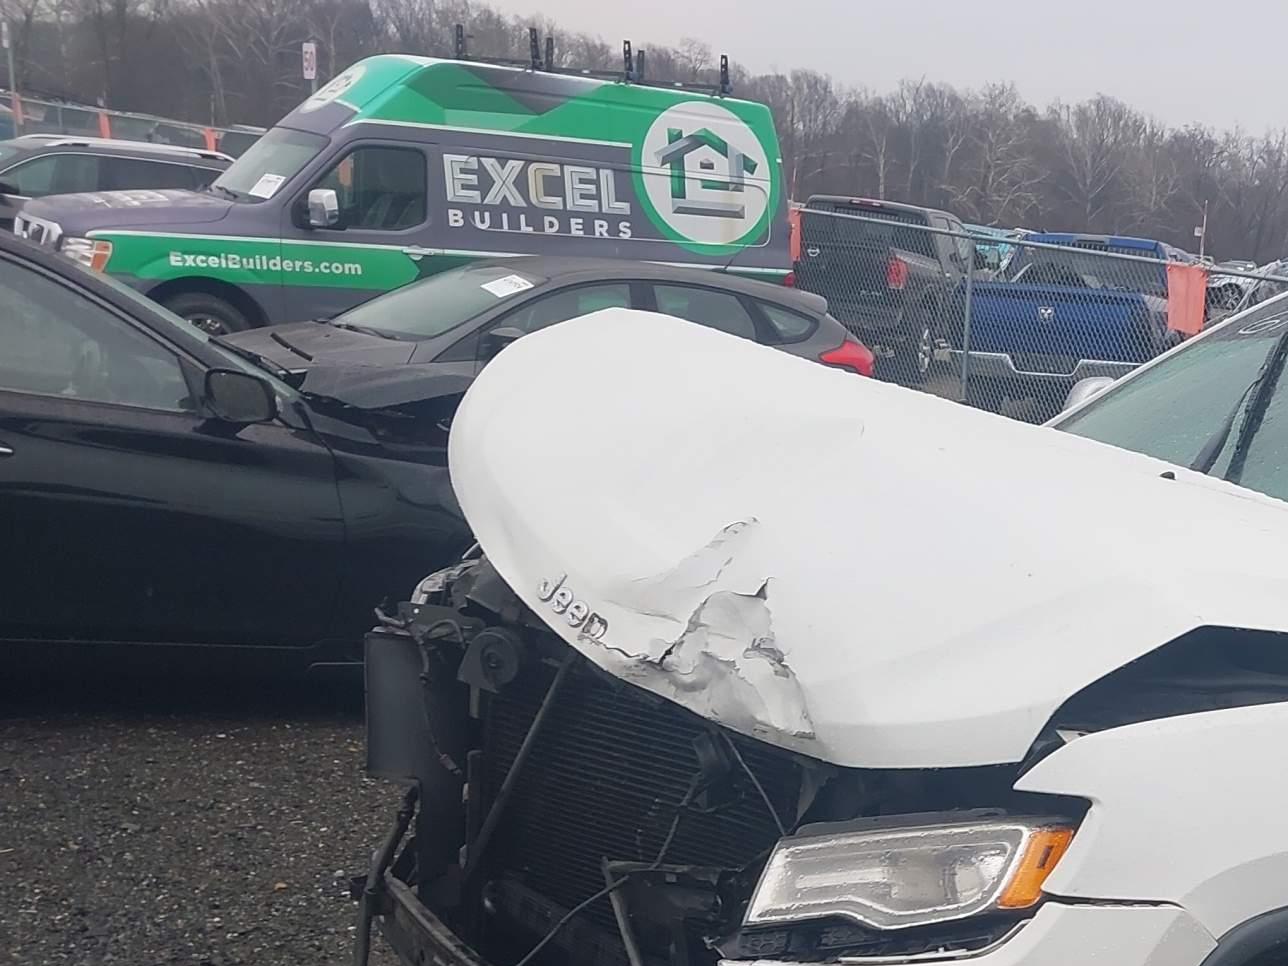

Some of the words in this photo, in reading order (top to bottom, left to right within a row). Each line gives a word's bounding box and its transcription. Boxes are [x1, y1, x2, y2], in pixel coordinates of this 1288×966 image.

[443, 153, 631, 215] EXCEL
[447, 208, 632, 239] BUILDERS
[169, 251, 362, 275] ExcelBuilders.com
[537, 573, 609, 640] Jeep
